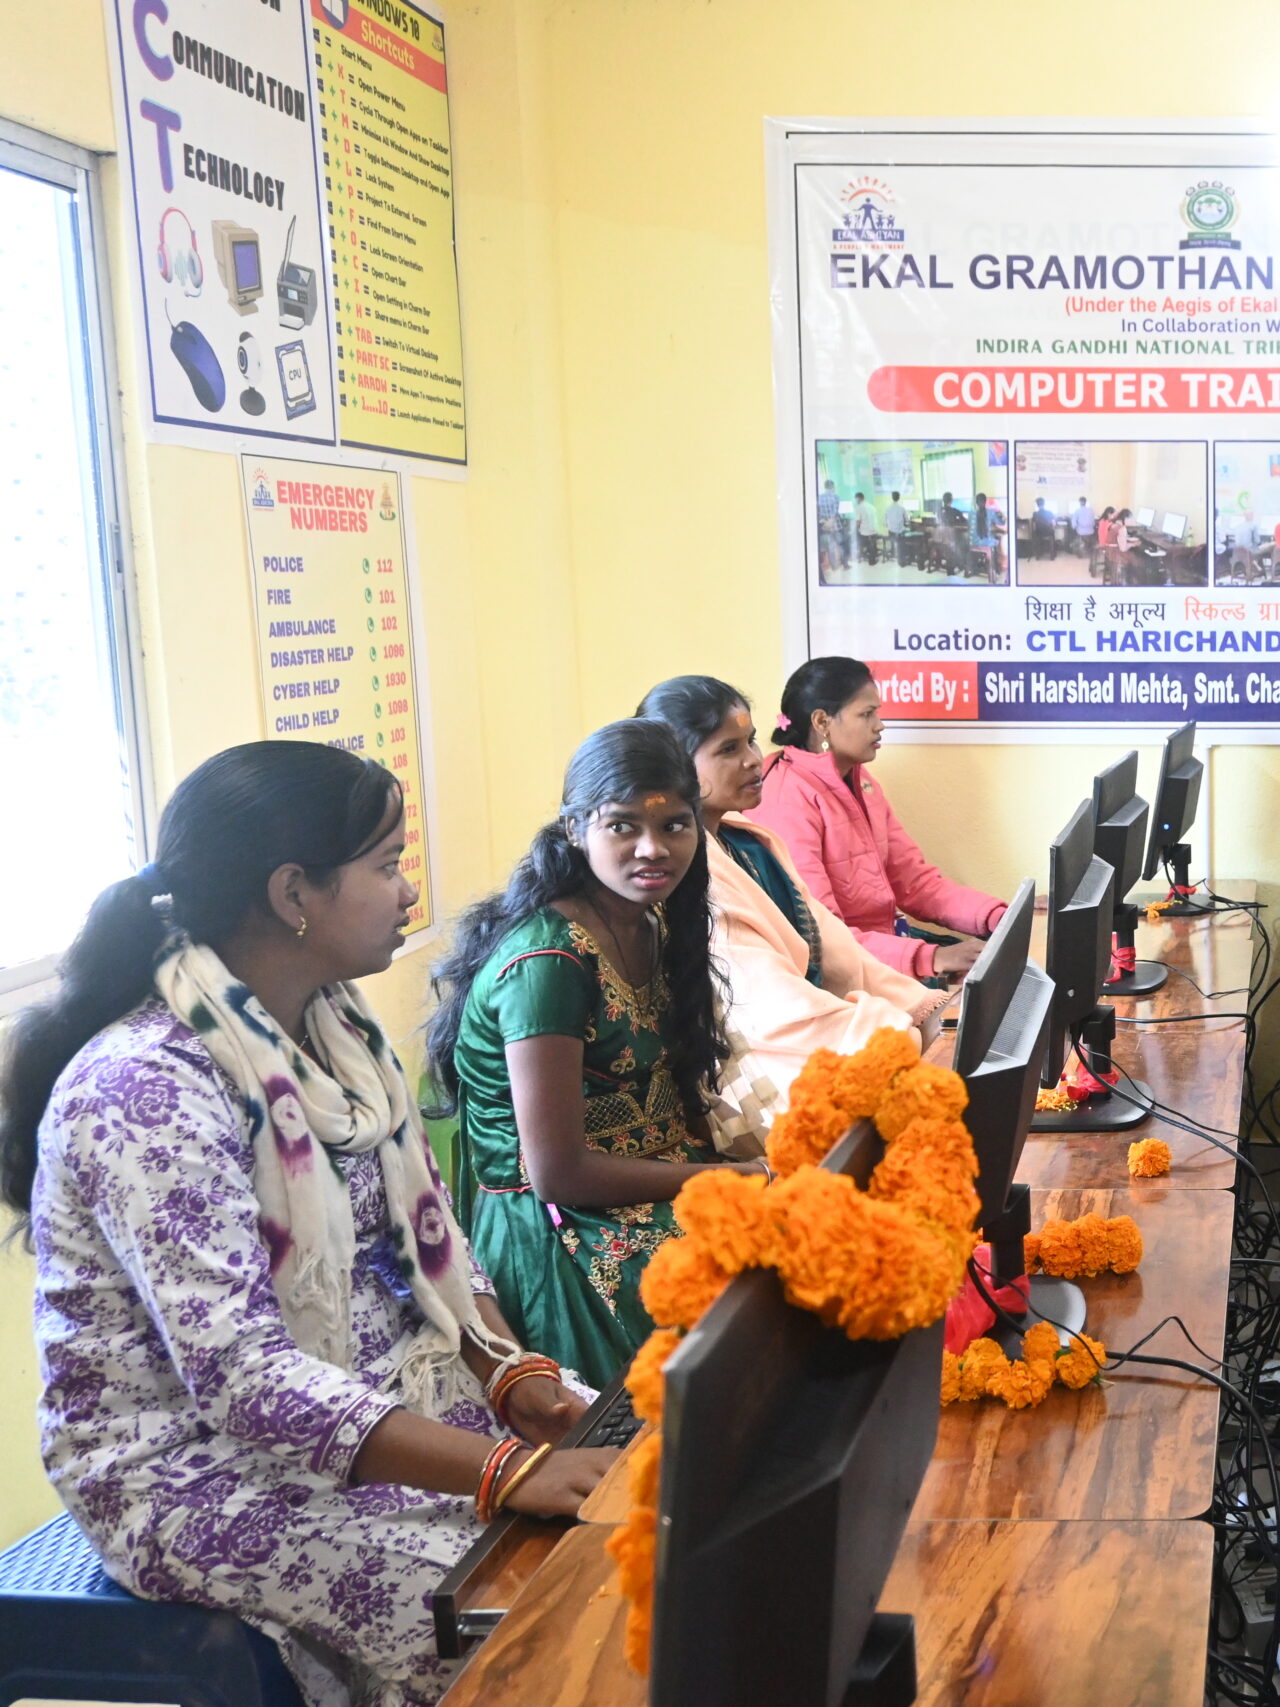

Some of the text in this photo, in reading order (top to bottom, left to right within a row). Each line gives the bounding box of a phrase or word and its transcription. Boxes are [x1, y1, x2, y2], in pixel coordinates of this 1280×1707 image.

[358, 0, 420, 41] NDOWS 10
[361, 20, 415, 70] Shortcuts
[358, 78, 372, 93] Open
[340, 89, 346, 104] T
[342, 113, 349, 129] M
[348, 185, 353, 199] P
[350, 208, 354, 222] F
[830, 253, 954, 289] EKAL
[968, 253, 1274, 290] GRAMOTHAN
[356, 304, 362, 318] H
[1065, 296, 1125, 316] (Under
[1130, 297, 1157, 313] the
[1162, 296, 1212, 316] Aegis
[1218, 296, 1235, 313] of
[1240, 297, 1278, 313] Ekal
[355, 326, 372, 345] TAB
[1121, 319, 1137, 333] In
[1142, 318, 1261, 333] Collaboration
[976, 339, 1043, 355] INDIRA
[1051, 339, 1128, 355] GANDHI
[1136, 339, 1235, 355] NATIONAL
[288, 367, 302, 381] CPU
[357, 372, 388, 393] ARROW
[933, 372, 1169, 409] COMPUTER
[276, 480, 375, 510] EMERGENCY
[290, 507, 368, 533] NUMBERS
[263, 556, 393, 573] POLICE 112
[267, 589, 396, 606] FIRE 101
[1025, 595, 1072, 621] शिक्षा
[1083, 595, 1097, 621] है
[1109, 602, 1167, 628] अमूल्य
[1184, 596, 1246, 621] स्किल्ड
[268, 616, 398, 639] AMBULANCE 102
[894, 629, 1011, 652] Location:
[1026, 630, 1086, 652] CTL
[270, 649, 325, 668] DISASTER
[327, 646, 354, 663] HELP
[273, 672, 406, 701] CYBER HELP 1930
[930, 672, 957, 711] By
[985, 672, 1025, 703] Shri
[1031, 672, 1114, 704] Harshad
[1120, 672, 1188, 711] Mehta,
[1194, 672, 1240, 704] Smt.
[275, 700, 408, 733] CHILD HELP 1098
[390, 728, 406, 744] 103
[393, 754, 408, 770] 108
